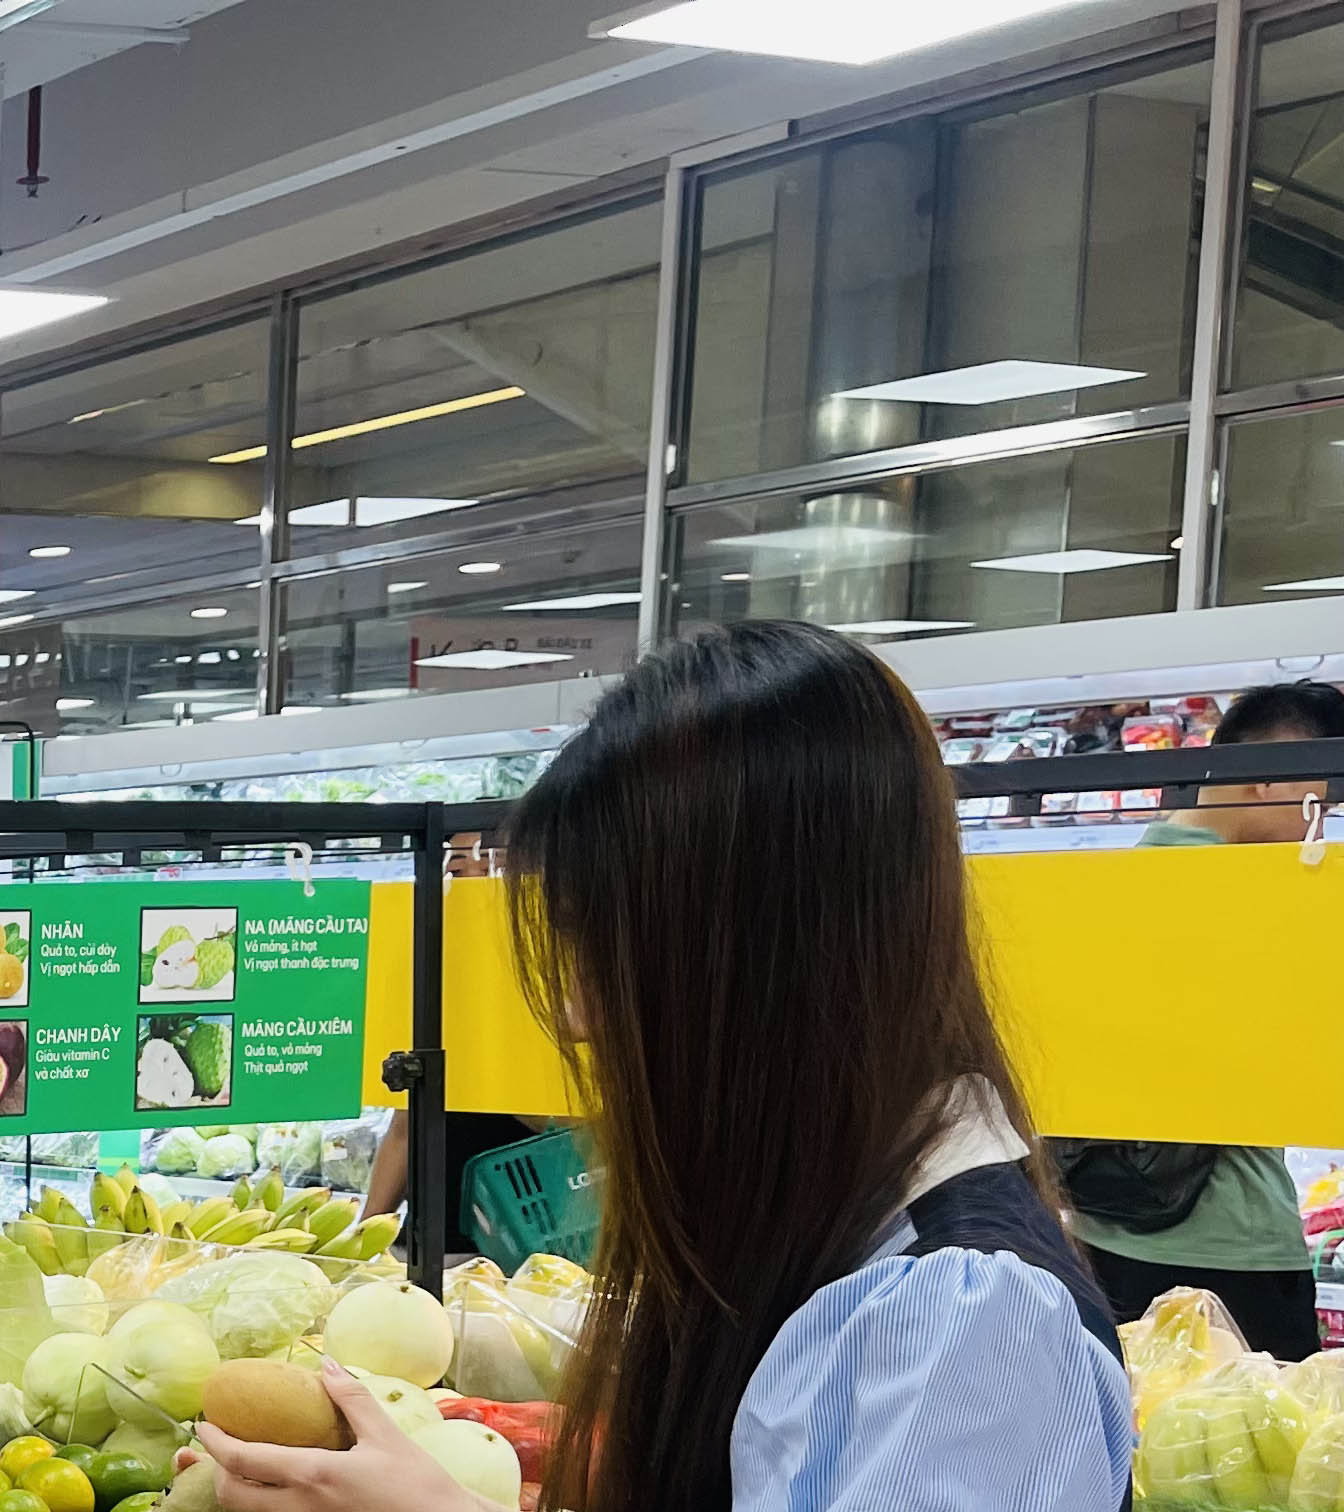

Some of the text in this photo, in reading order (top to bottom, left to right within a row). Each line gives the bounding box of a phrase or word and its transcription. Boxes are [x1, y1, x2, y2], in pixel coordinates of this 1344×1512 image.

[41, 920, 83, 939] NHÃN
[245, 919, 265, 935] NA
[346, 917, 368, 934] TA)
[64, 945, 78, 957] to,
[36, 1023, 122, 1044] CHANH DÂY
[318, 1016, 353, 1035] XIÊM
[62, 1048, 100, 1061] vitamin
[102, 1047, 110, 1060] C
